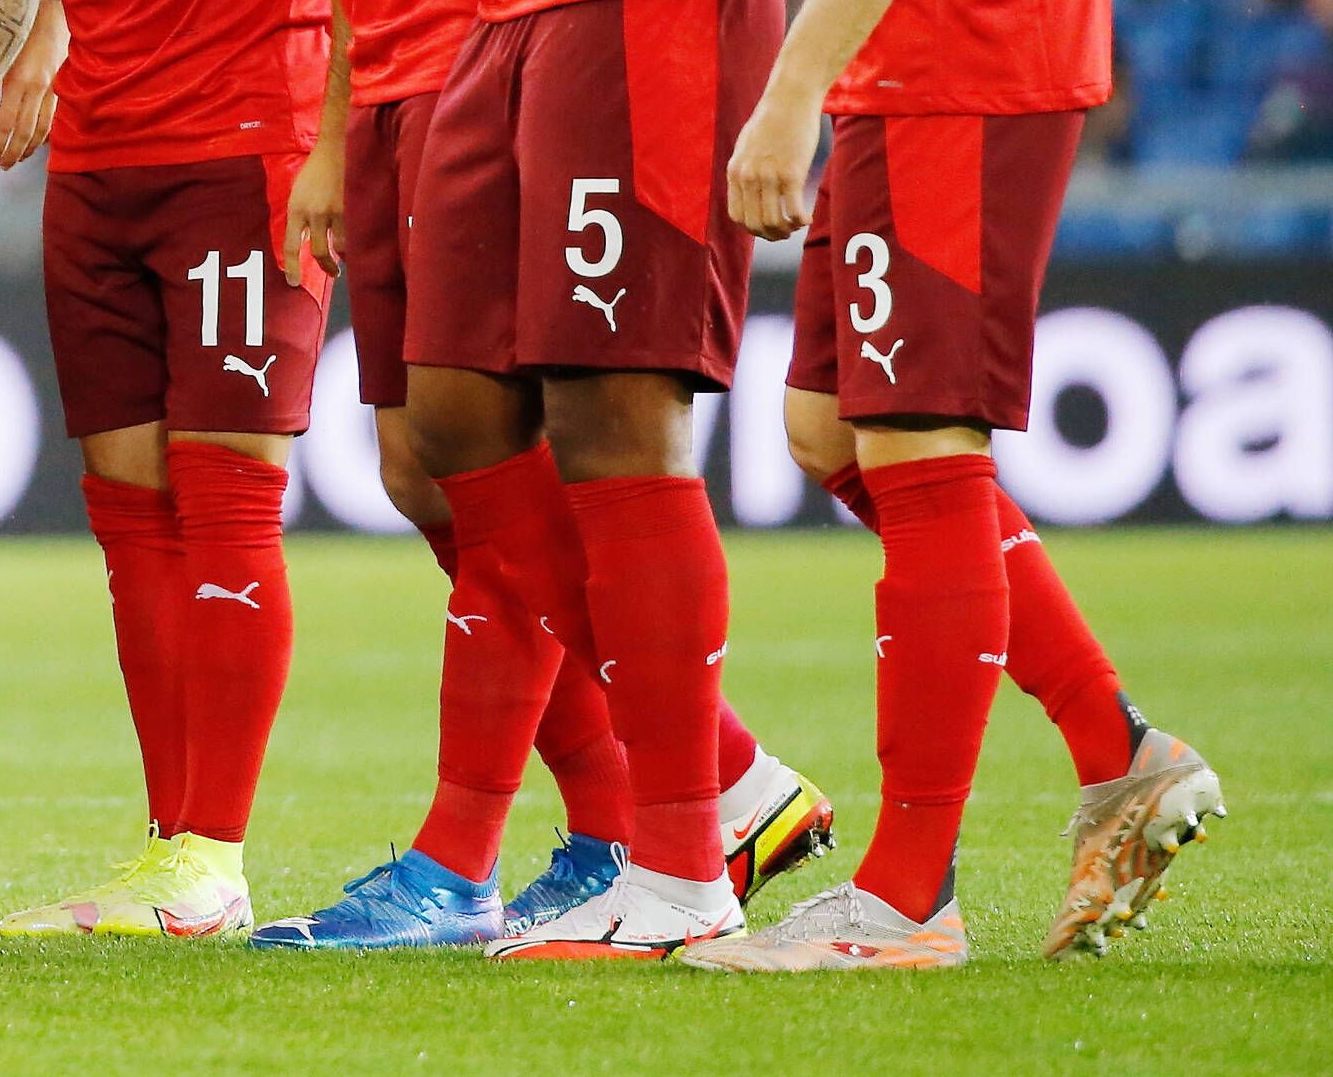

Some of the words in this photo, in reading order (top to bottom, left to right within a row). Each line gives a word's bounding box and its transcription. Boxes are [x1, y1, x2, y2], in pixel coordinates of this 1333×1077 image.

[564, 177, 624, 278] 5
[187, 249, 264, 347] 11
[844, 232, 893, 334] 3
